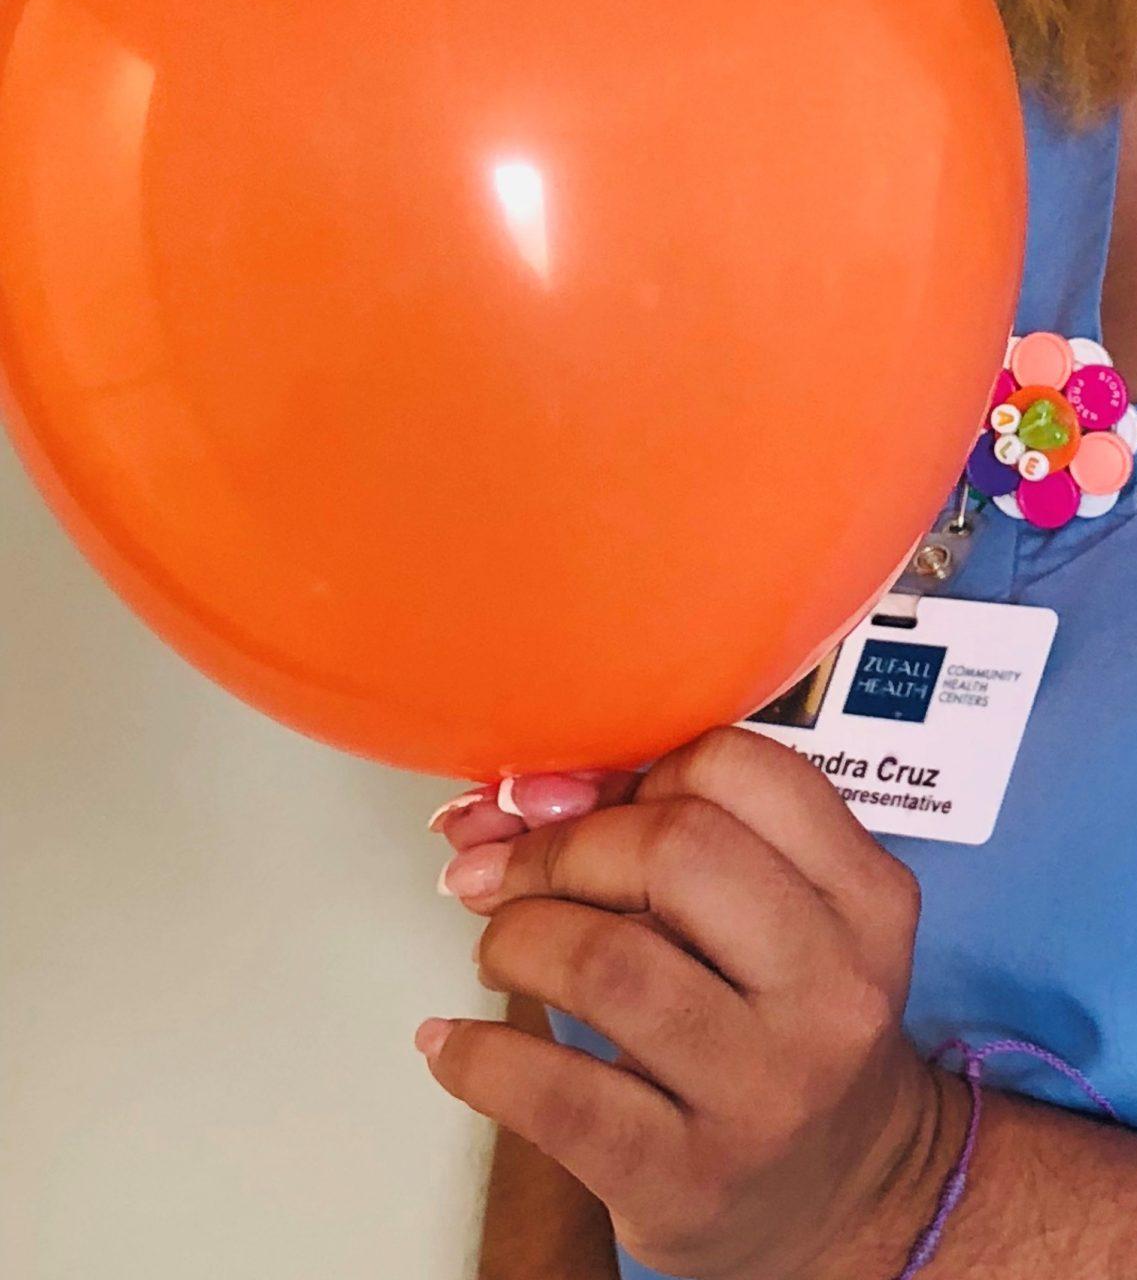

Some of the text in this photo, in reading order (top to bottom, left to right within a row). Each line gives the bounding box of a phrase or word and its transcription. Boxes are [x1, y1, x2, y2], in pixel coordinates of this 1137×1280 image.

[863, 655, 931, 679] ZUFALL
[946, 663, 1022, 682] COMMUNITY
[857, 677, 930, 700] HEALTH
[942, 678, 989, 693] HEALTH
[938, 691, 989, 707] CENTERS
[791, 744, 941, 788] ndra Cruz
[836, 785, 953, 815] presentative
